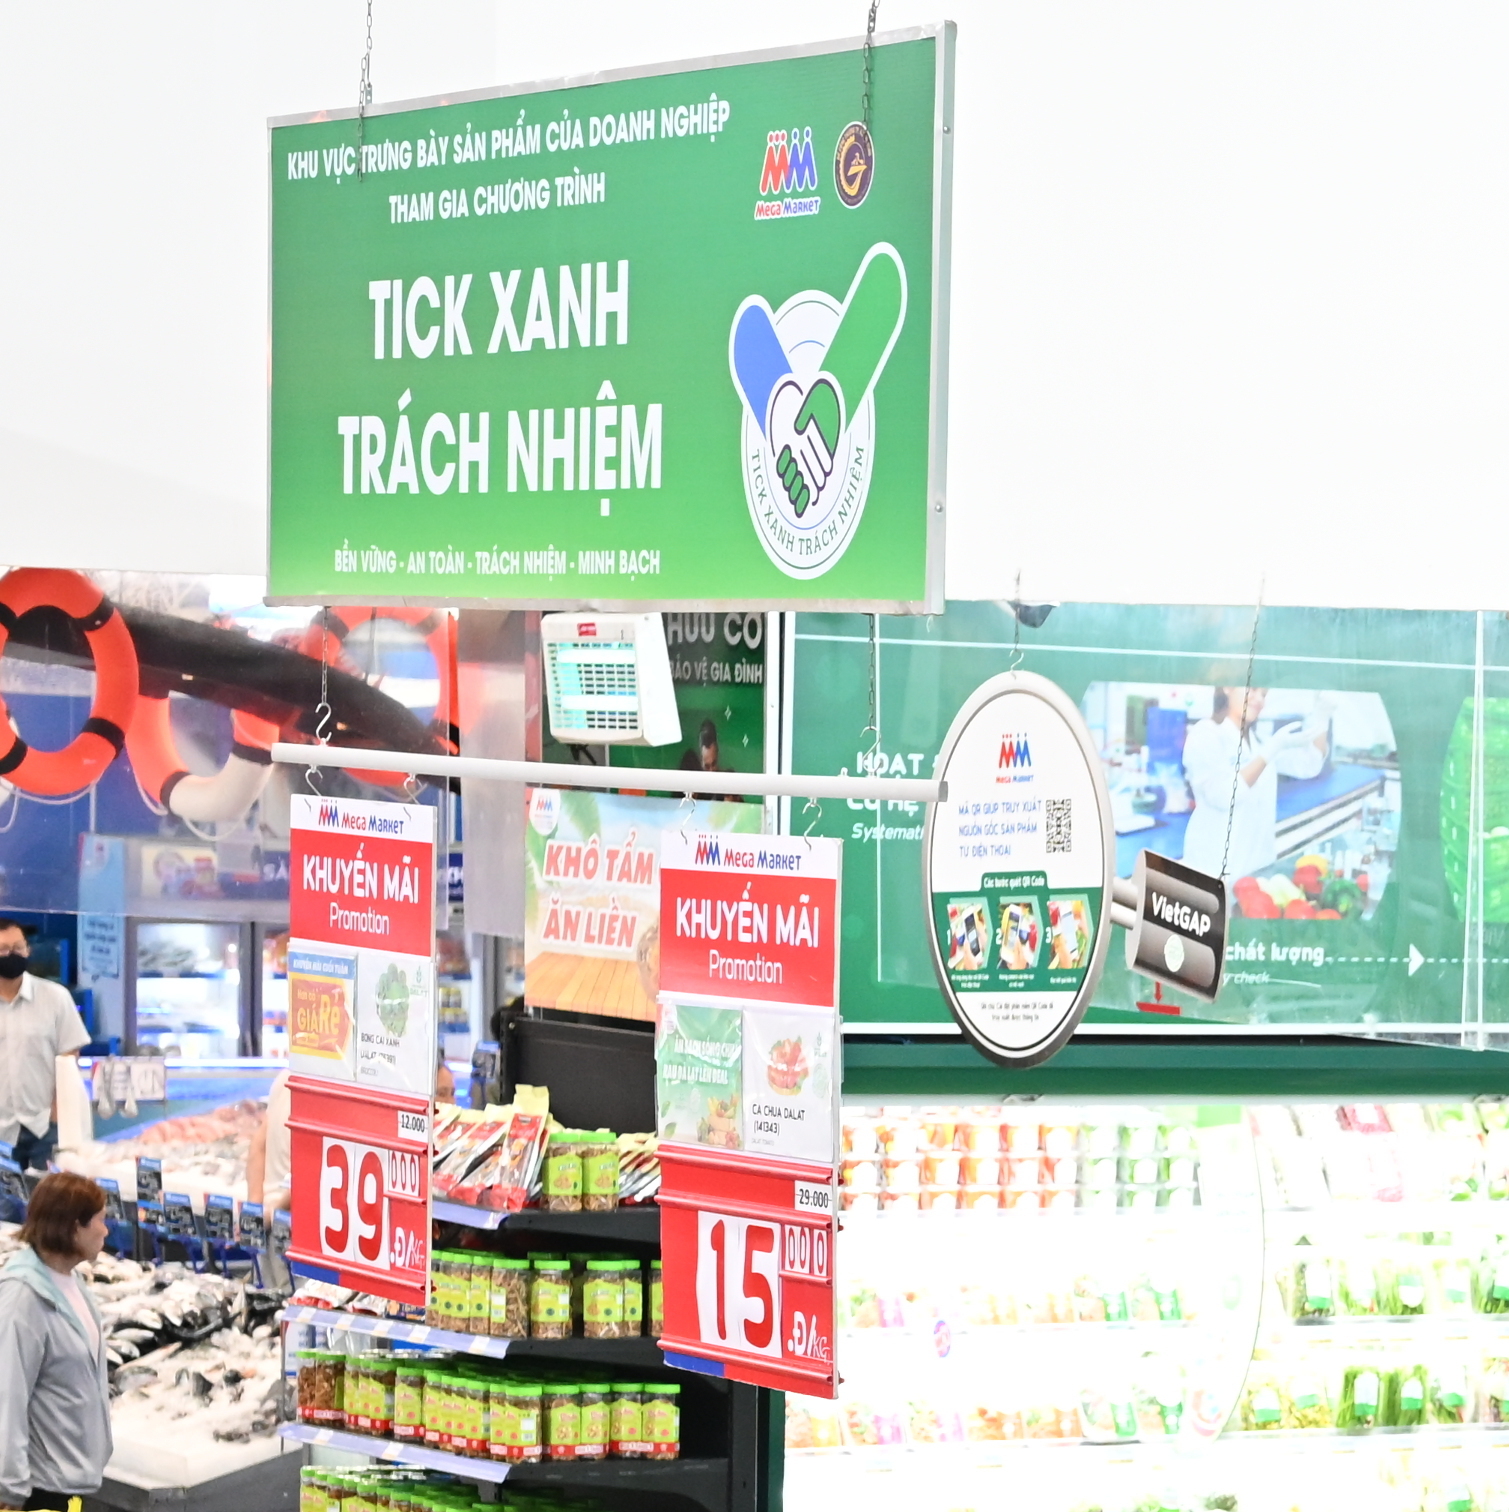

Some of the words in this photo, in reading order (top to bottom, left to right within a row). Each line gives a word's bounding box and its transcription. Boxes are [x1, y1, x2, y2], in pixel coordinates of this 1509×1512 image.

[288, 151, 318, 179] KHU
[323, 146, 355, 184] VỰC
[361, 138, 412, 174] TRƯNG
[417, 129, 448, 168] BÀY
[453, 122, 486, 164] SẢN
[491, 109, 540, 158] PHẨM
[546, 109, 583, 151] CỦA
[589, 110, 655, 146] DOANH
[661, 93, 730, 142] NGHIỆP
[389, 191, 433, 224] THAM
[439, 189, 469, 219] GIA
[474, 178, 550, 216] CHƯƠNG
[555, 167, 605, 207] TRÌNH
[369, 274, 472, 360] TICK
[488, 260, 630, 353] XANH
[338, 388, 489, 495] TRÁCH
[508, 380, 662, 516] NHIỆM
[334, 538, 358, 574] BỀN
[361, 543, 396, 574] VỮNG
[407, 550, 425, 574] AN
[429, 543, 464, 574] TOÀN
[475, 543, 519, 574] TRÁCH
[522, 543, 566, 581] NHIỆM
[578, 550, 610, 574] MINH
[614, 549, 660, 581] BẠCH
[303, 842, 378, 899] KHUYẾN
[384, 856, 418, 903] MÃI
[545, 834, 599, 880] KHÔ
[606, 827, 654, 886] TẨM
[330, 902, 389, 934] Promotion
[544, 892, 582, 941] ĂN
[584, 896, 636, 947] LIỀN
[676, 882, 768, 944] KHUYẾN
[776, 894, 819, 947] MÃI
[1152, 892, 1210, 937] VietGAP
[710, 949, 782, 983] Promotion
[401, 1114, 425, 1133] 12.000
[752, 1103, 762, 1116] CA
[764, 1105, 782, 1118] CHUA
[784, 1107, 805, 1121] DALAT
[754, 1119, 780, 1135] (141343)
[325, 1144, 384, 1261] 39
[799, 1189, 829, 1208] 29.000
[711, 1220, 774, 1348] 15
